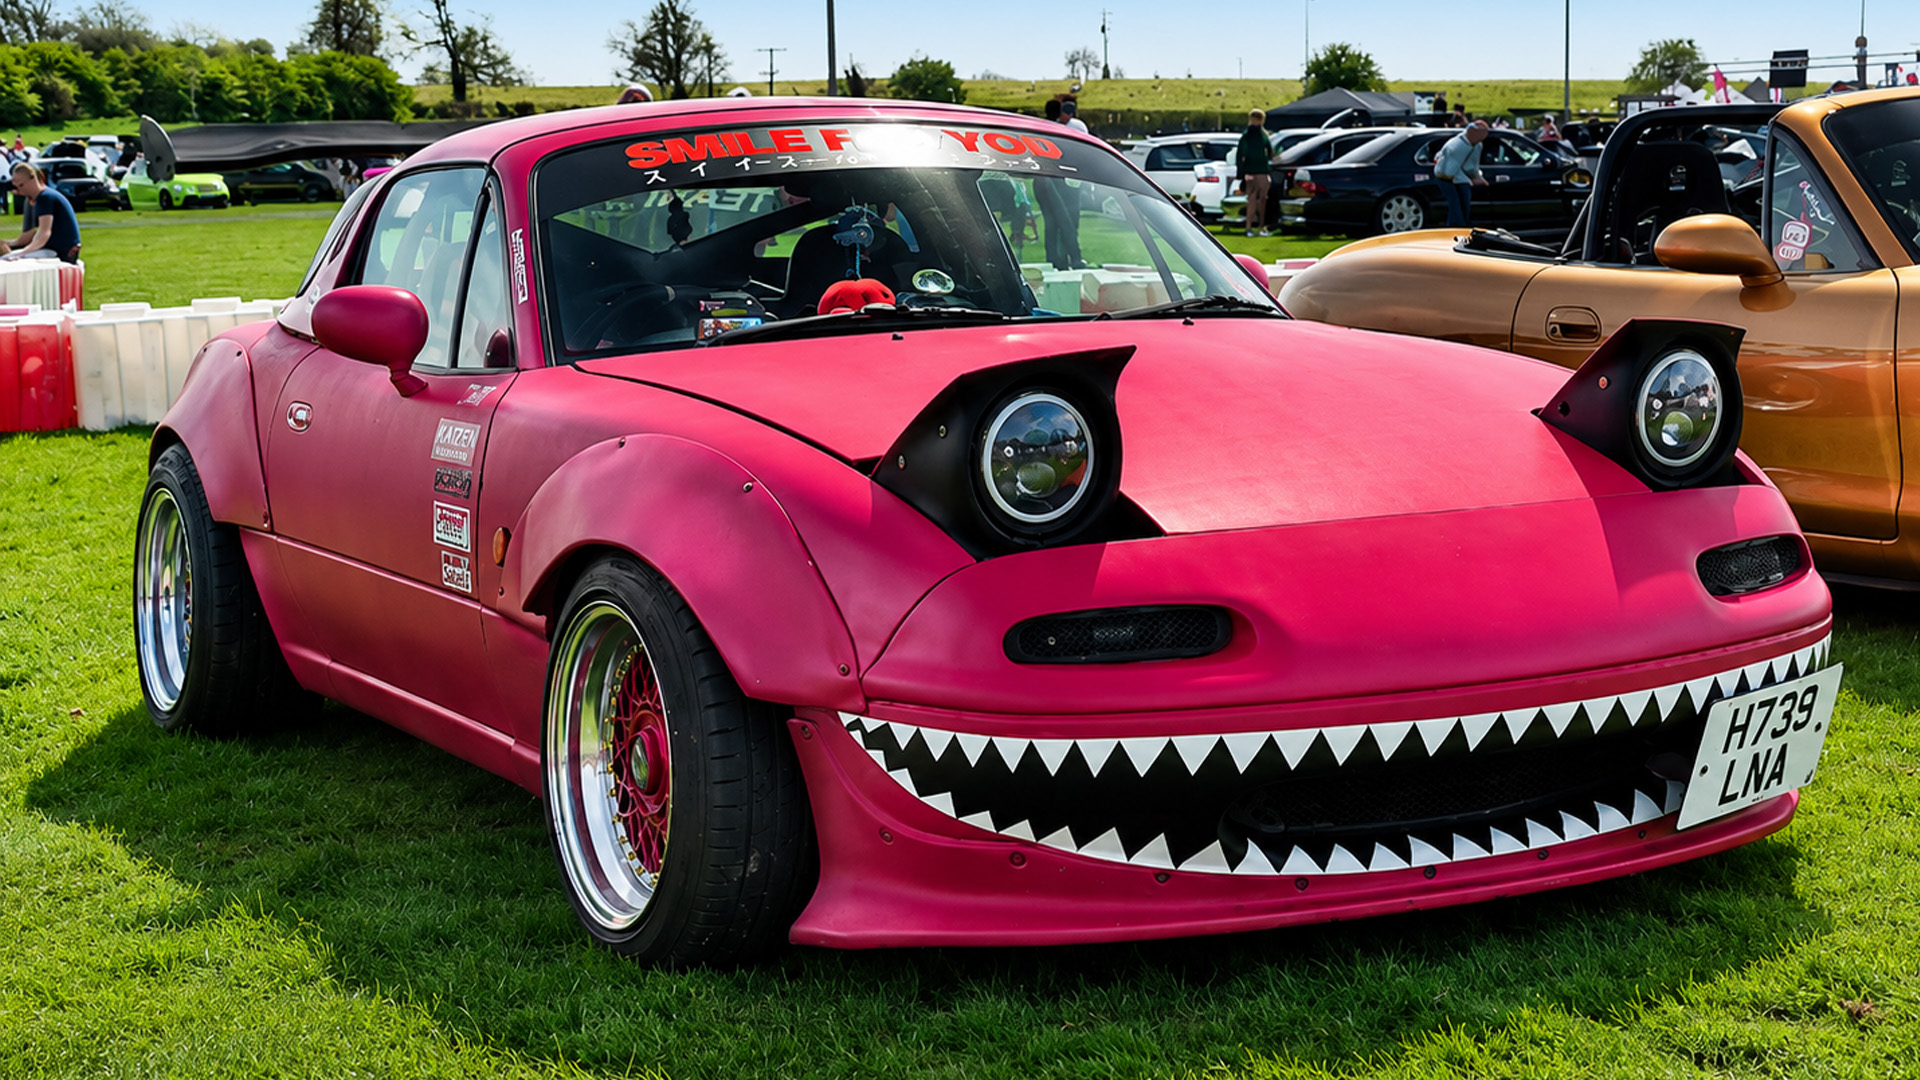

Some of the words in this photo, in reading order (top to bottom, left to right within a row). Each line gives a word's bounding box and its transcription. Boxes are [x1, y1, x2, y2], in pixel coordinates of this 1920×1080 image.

[625, 129, 813, 169] SMILE
[1721, 684, 1819, 755] H739
[1717, 743, 1788, 807] LNA
